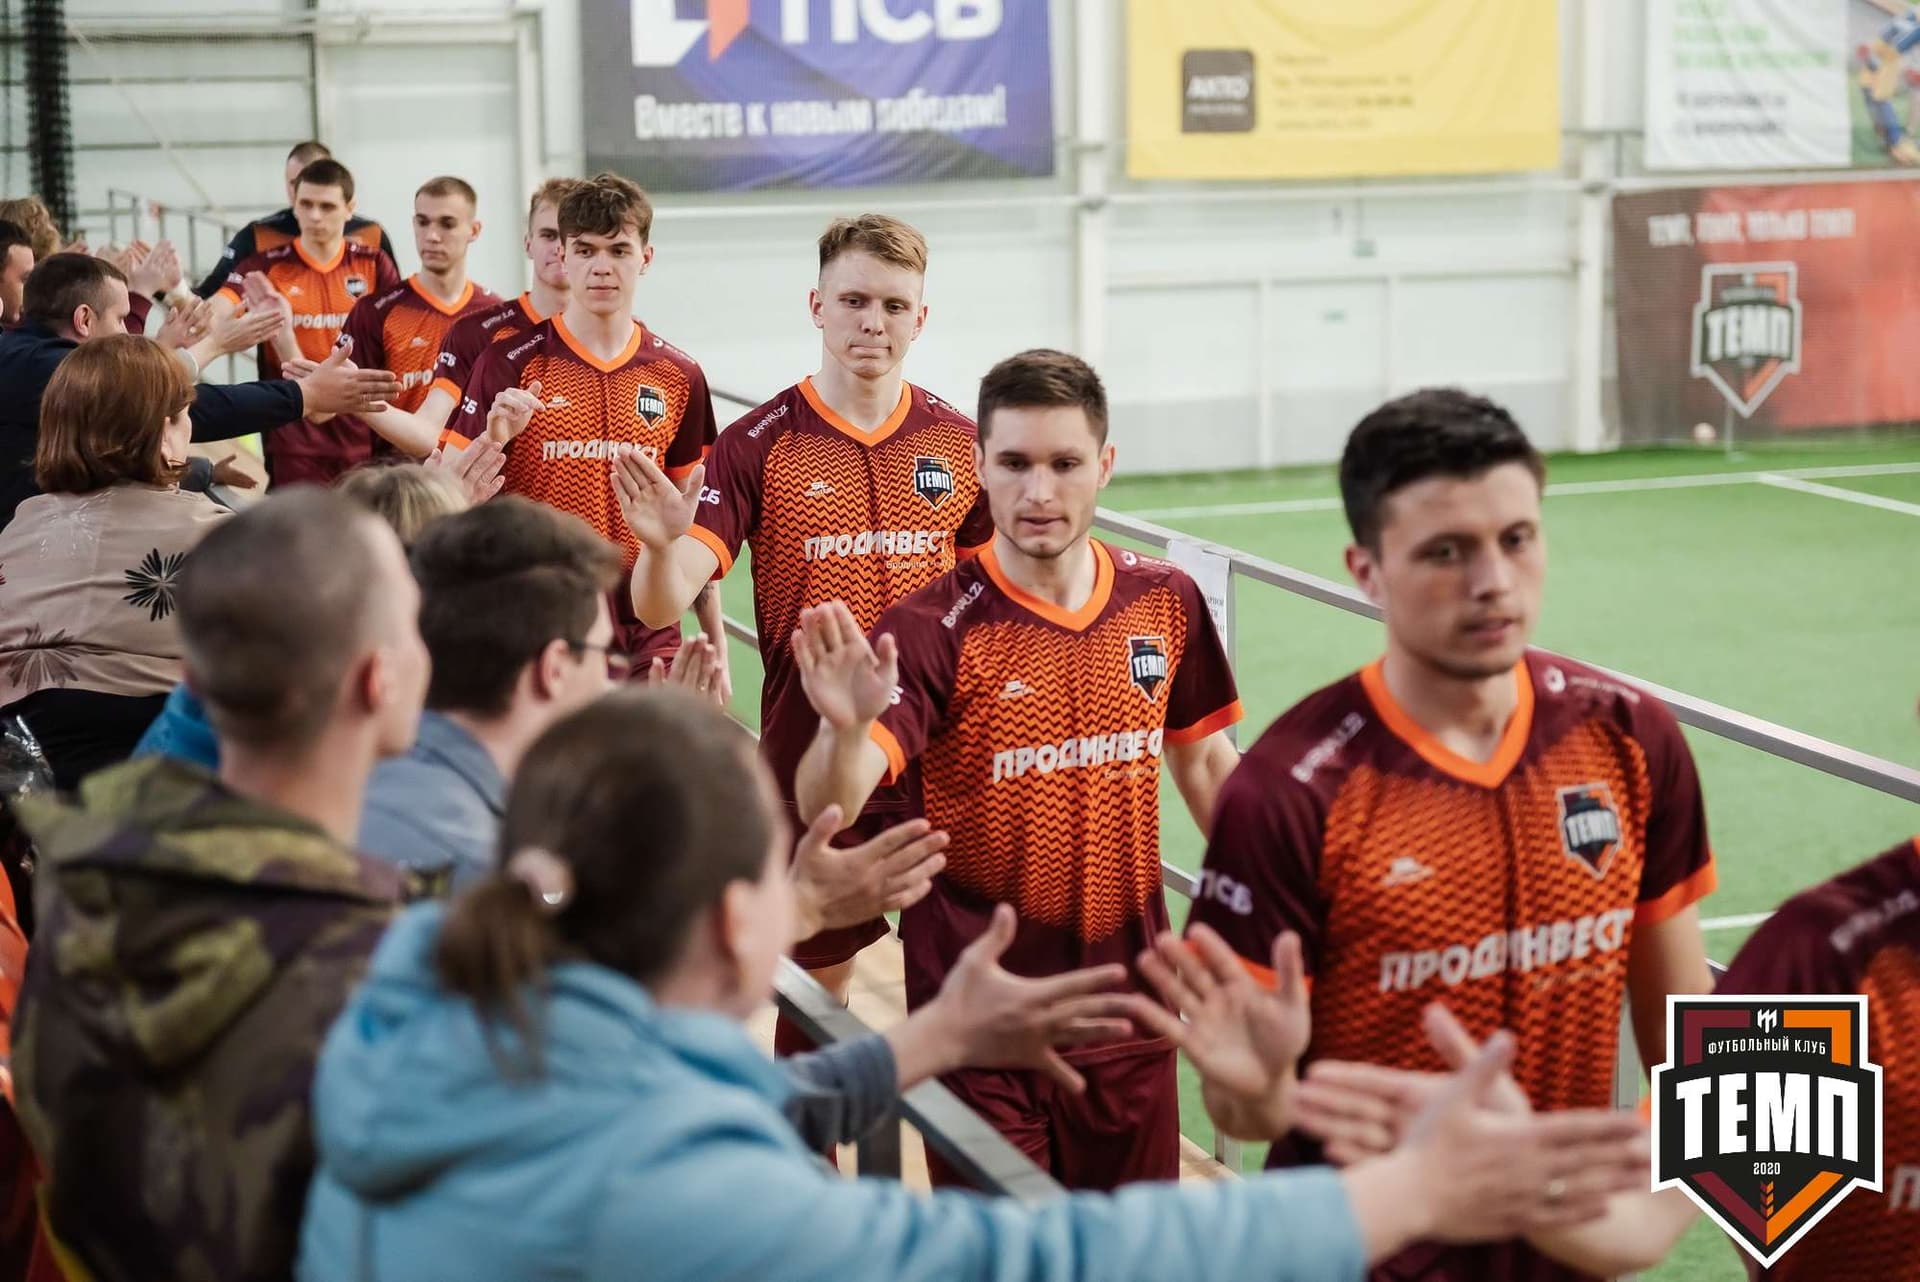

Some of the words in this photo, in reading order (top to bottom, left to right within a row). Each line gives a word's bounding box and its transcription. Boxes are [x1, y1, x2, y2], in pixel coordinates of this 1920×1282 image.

[634, 95, 743, 140] Вместе
[746, 102, 768, 137] к
[1705, 304, 1791, 361] ТЕМП
[639, 397, 663, 416] ТЕМП
[699, 485, 721, 505] СБ
[917, 471, 950, 491] ТЕМП
[1132, 655, 1166, 679] ТЕМП
[1566, 810, 1618, 848] ТЕМП
[1192, 869, 1254, 915] ПСБ
[1378, 907, 1635, 992] ПРОДИНВЕСТ
